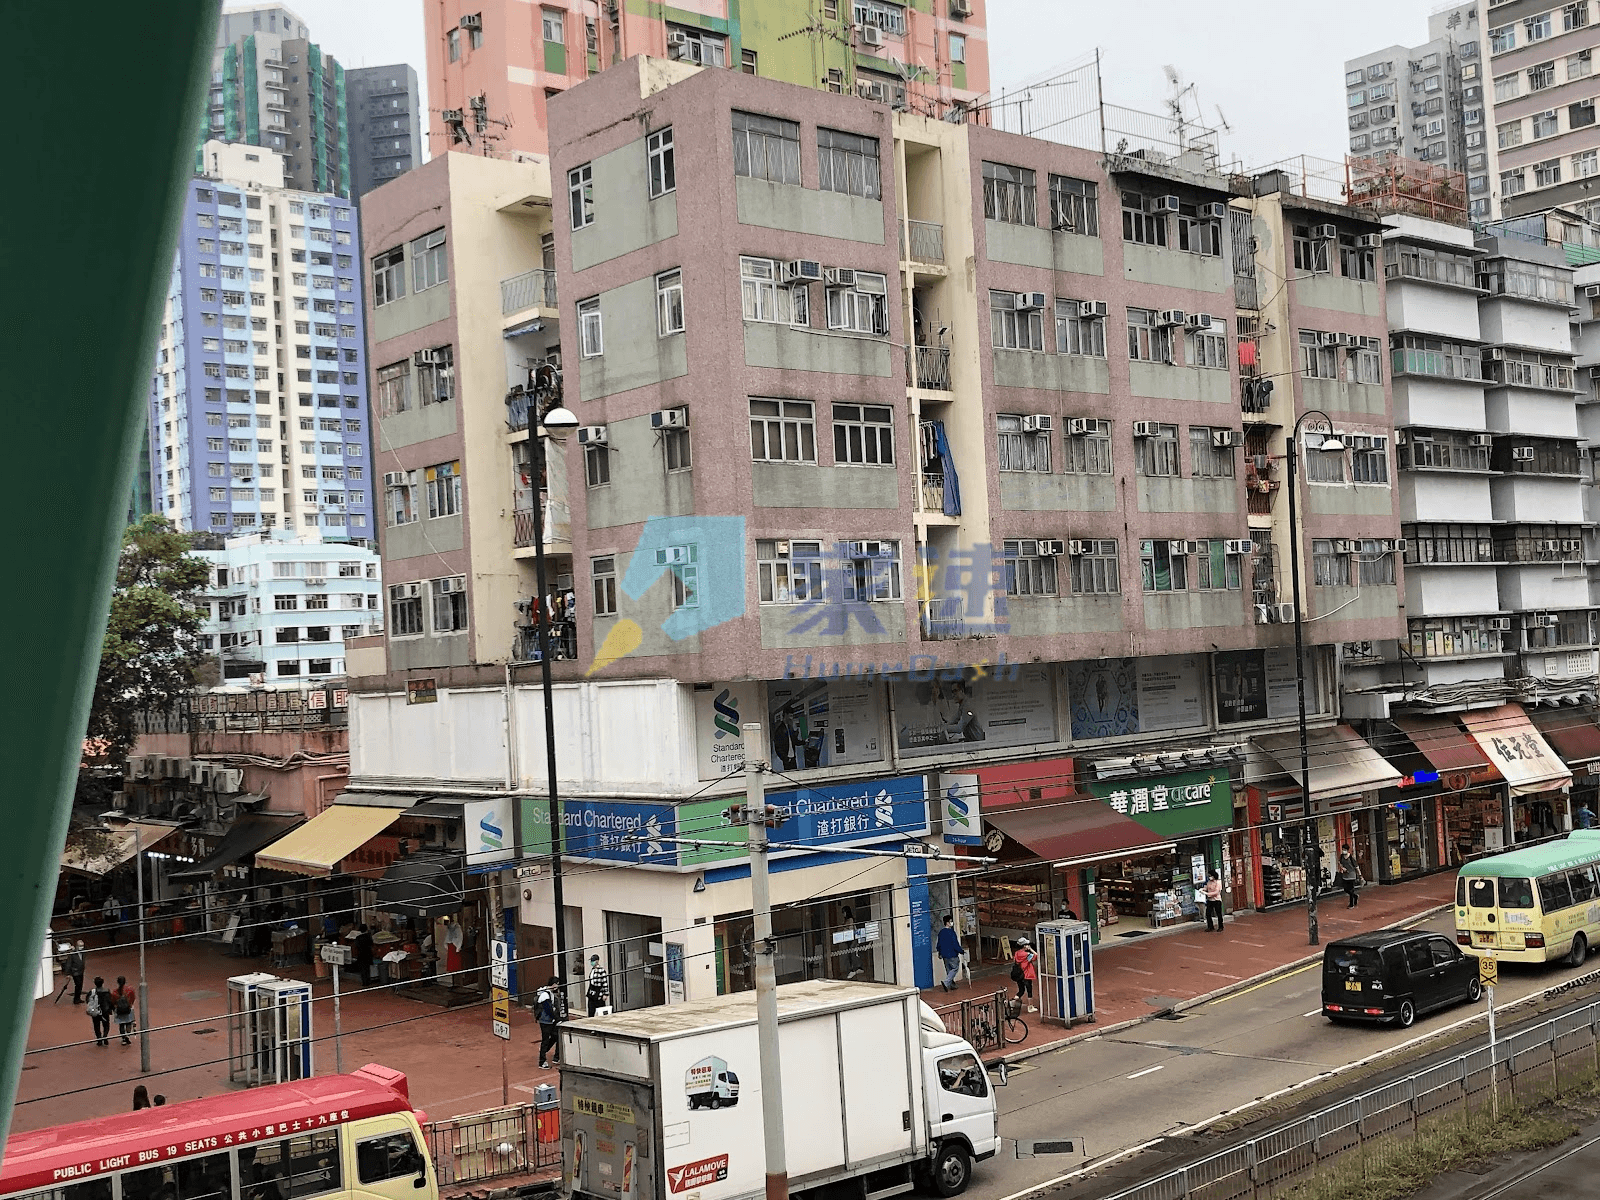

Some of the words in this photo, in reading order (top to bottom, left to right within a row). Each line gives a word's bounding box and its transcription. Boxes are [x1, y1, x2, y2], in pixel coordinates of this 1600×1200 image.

[796, 791, 869, 817] Chartered
[1109, 784, 1169, 815] 華潤堂
[533, 807, 582, 827] Stadard
[584, 809, 642, 830] Chartered
[817, 814, 870, 836] 渣打銀行
[1482, 961, 1494, 971] 35
[53, 1163, 92, 1180] PUBLIC
[99, 1155, 131, 1170] LIGHT
[138, 1149, 159, 1162] BUS
[166, 1146, 178, 1156] 19
[184, 1137, 218, 1152] SEATS
[685, 1159, 726, 1178] LALAMOVE
